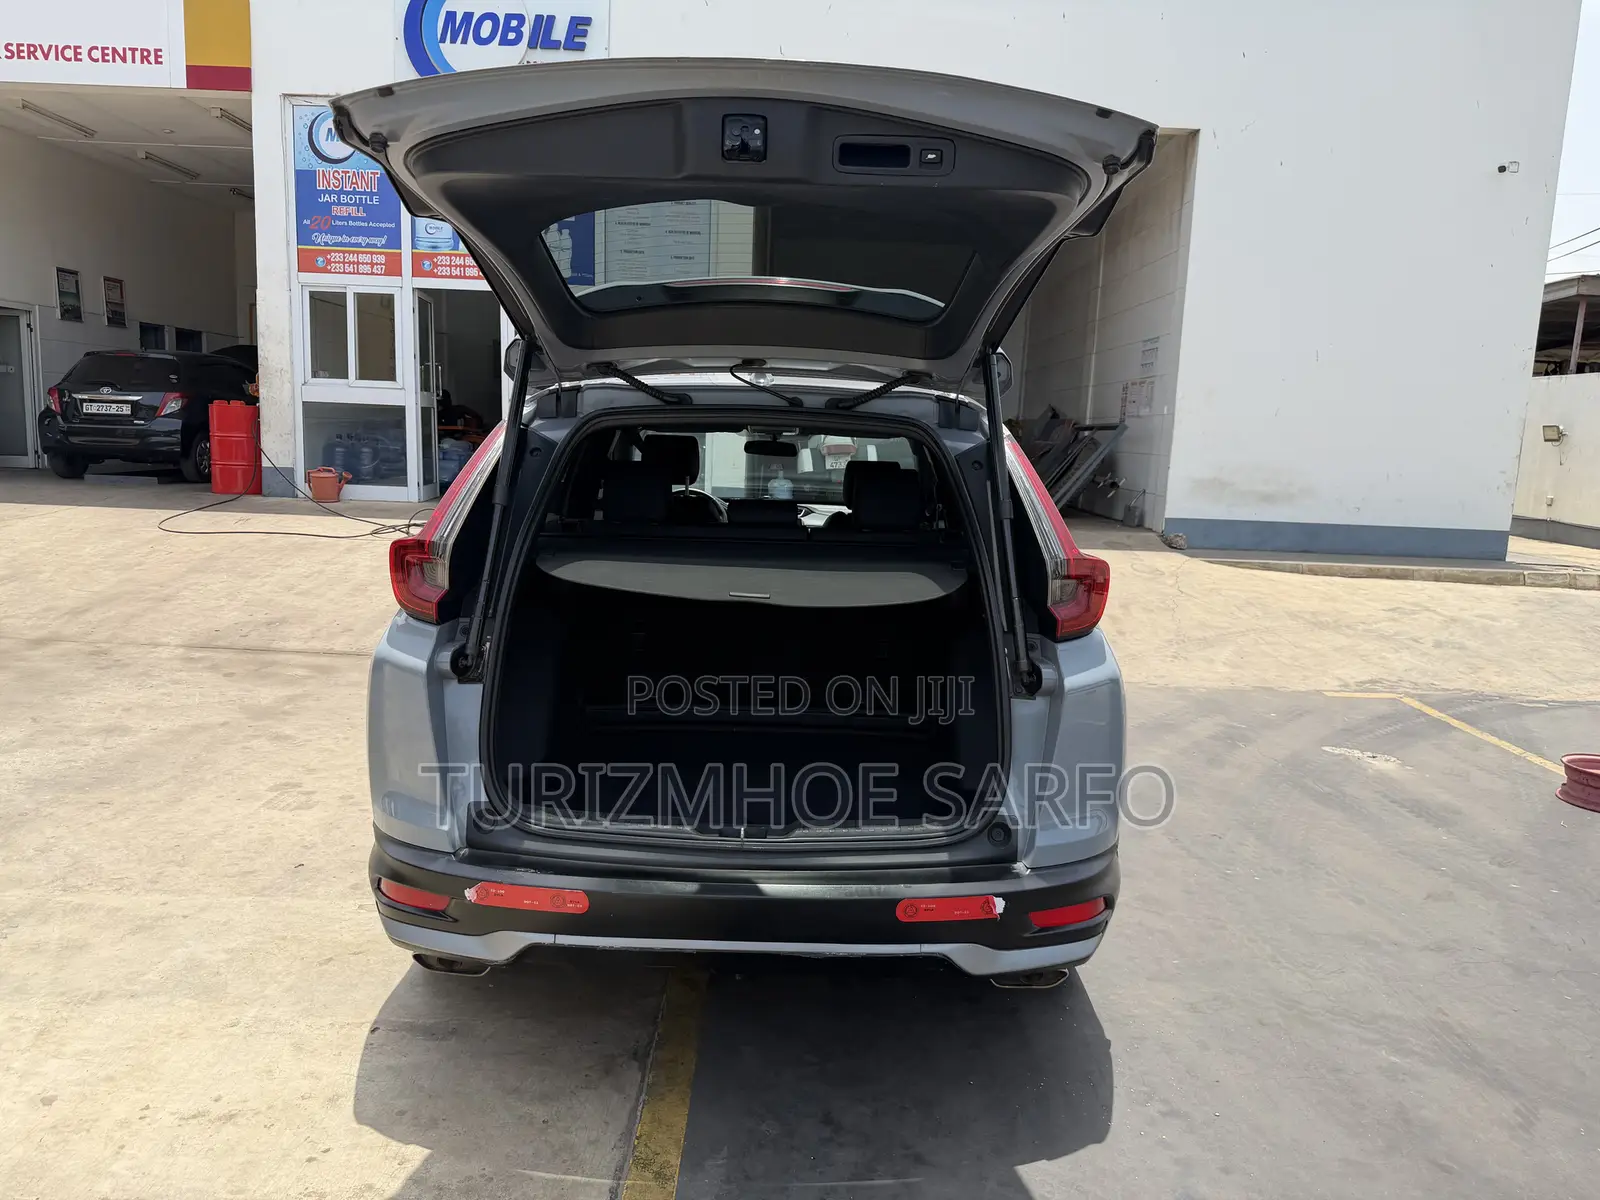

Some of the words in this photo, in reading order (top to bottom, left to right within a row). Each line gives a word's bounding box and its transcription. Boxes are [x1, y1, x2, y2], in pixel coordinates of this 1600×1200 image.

[439, 11, 592, 51] MOBILE
[4, 42, 82, 62] SERVICE
[87, 46, 163, 65] CENTRE
[316, 168, 380, 192] INSTANT
[318, 194, 337, 203] JAR
[340, 195, 379, 204] BOTTLE
[331, 206, 366, 216] REFILL
[309, 216, 332, 230] 20
[326, 252, 344, 262] +233
[344, 253, 357, 263] 244
[372, 254, 386, 264] 939
[433, 256, 450, 265] +233
[451, 256, 464, 265] 244
[326, 263, 344, 272] +233
[372, 265, 386, 274] 437
[433, 266, 450, 275] +233
